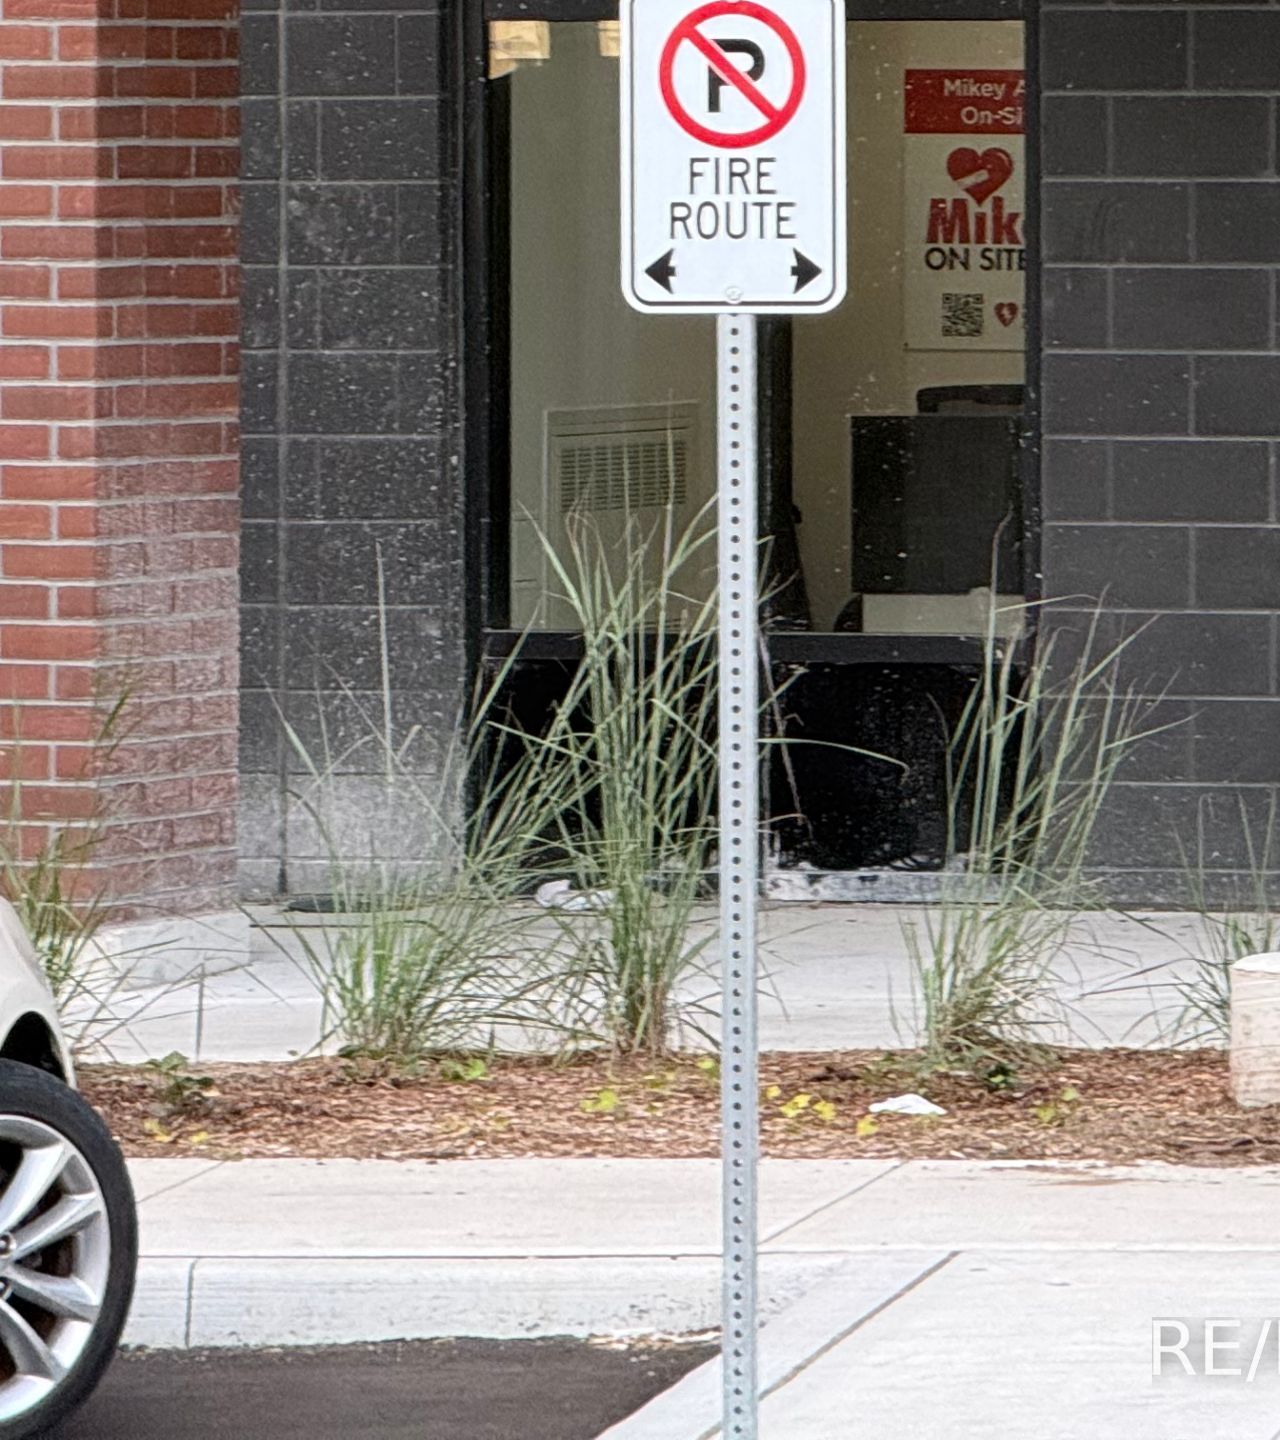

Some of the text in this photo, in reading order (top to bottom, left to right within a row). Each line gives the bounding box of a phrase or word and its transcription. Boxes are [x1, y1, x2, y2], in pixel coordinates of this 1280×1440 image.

[943, 78, 1006, 100] Mikey
[689, 157, 777, 195] FIRE
[669, 201, 797, 240] ROUTE
[925, 247, 970, 270] ON
